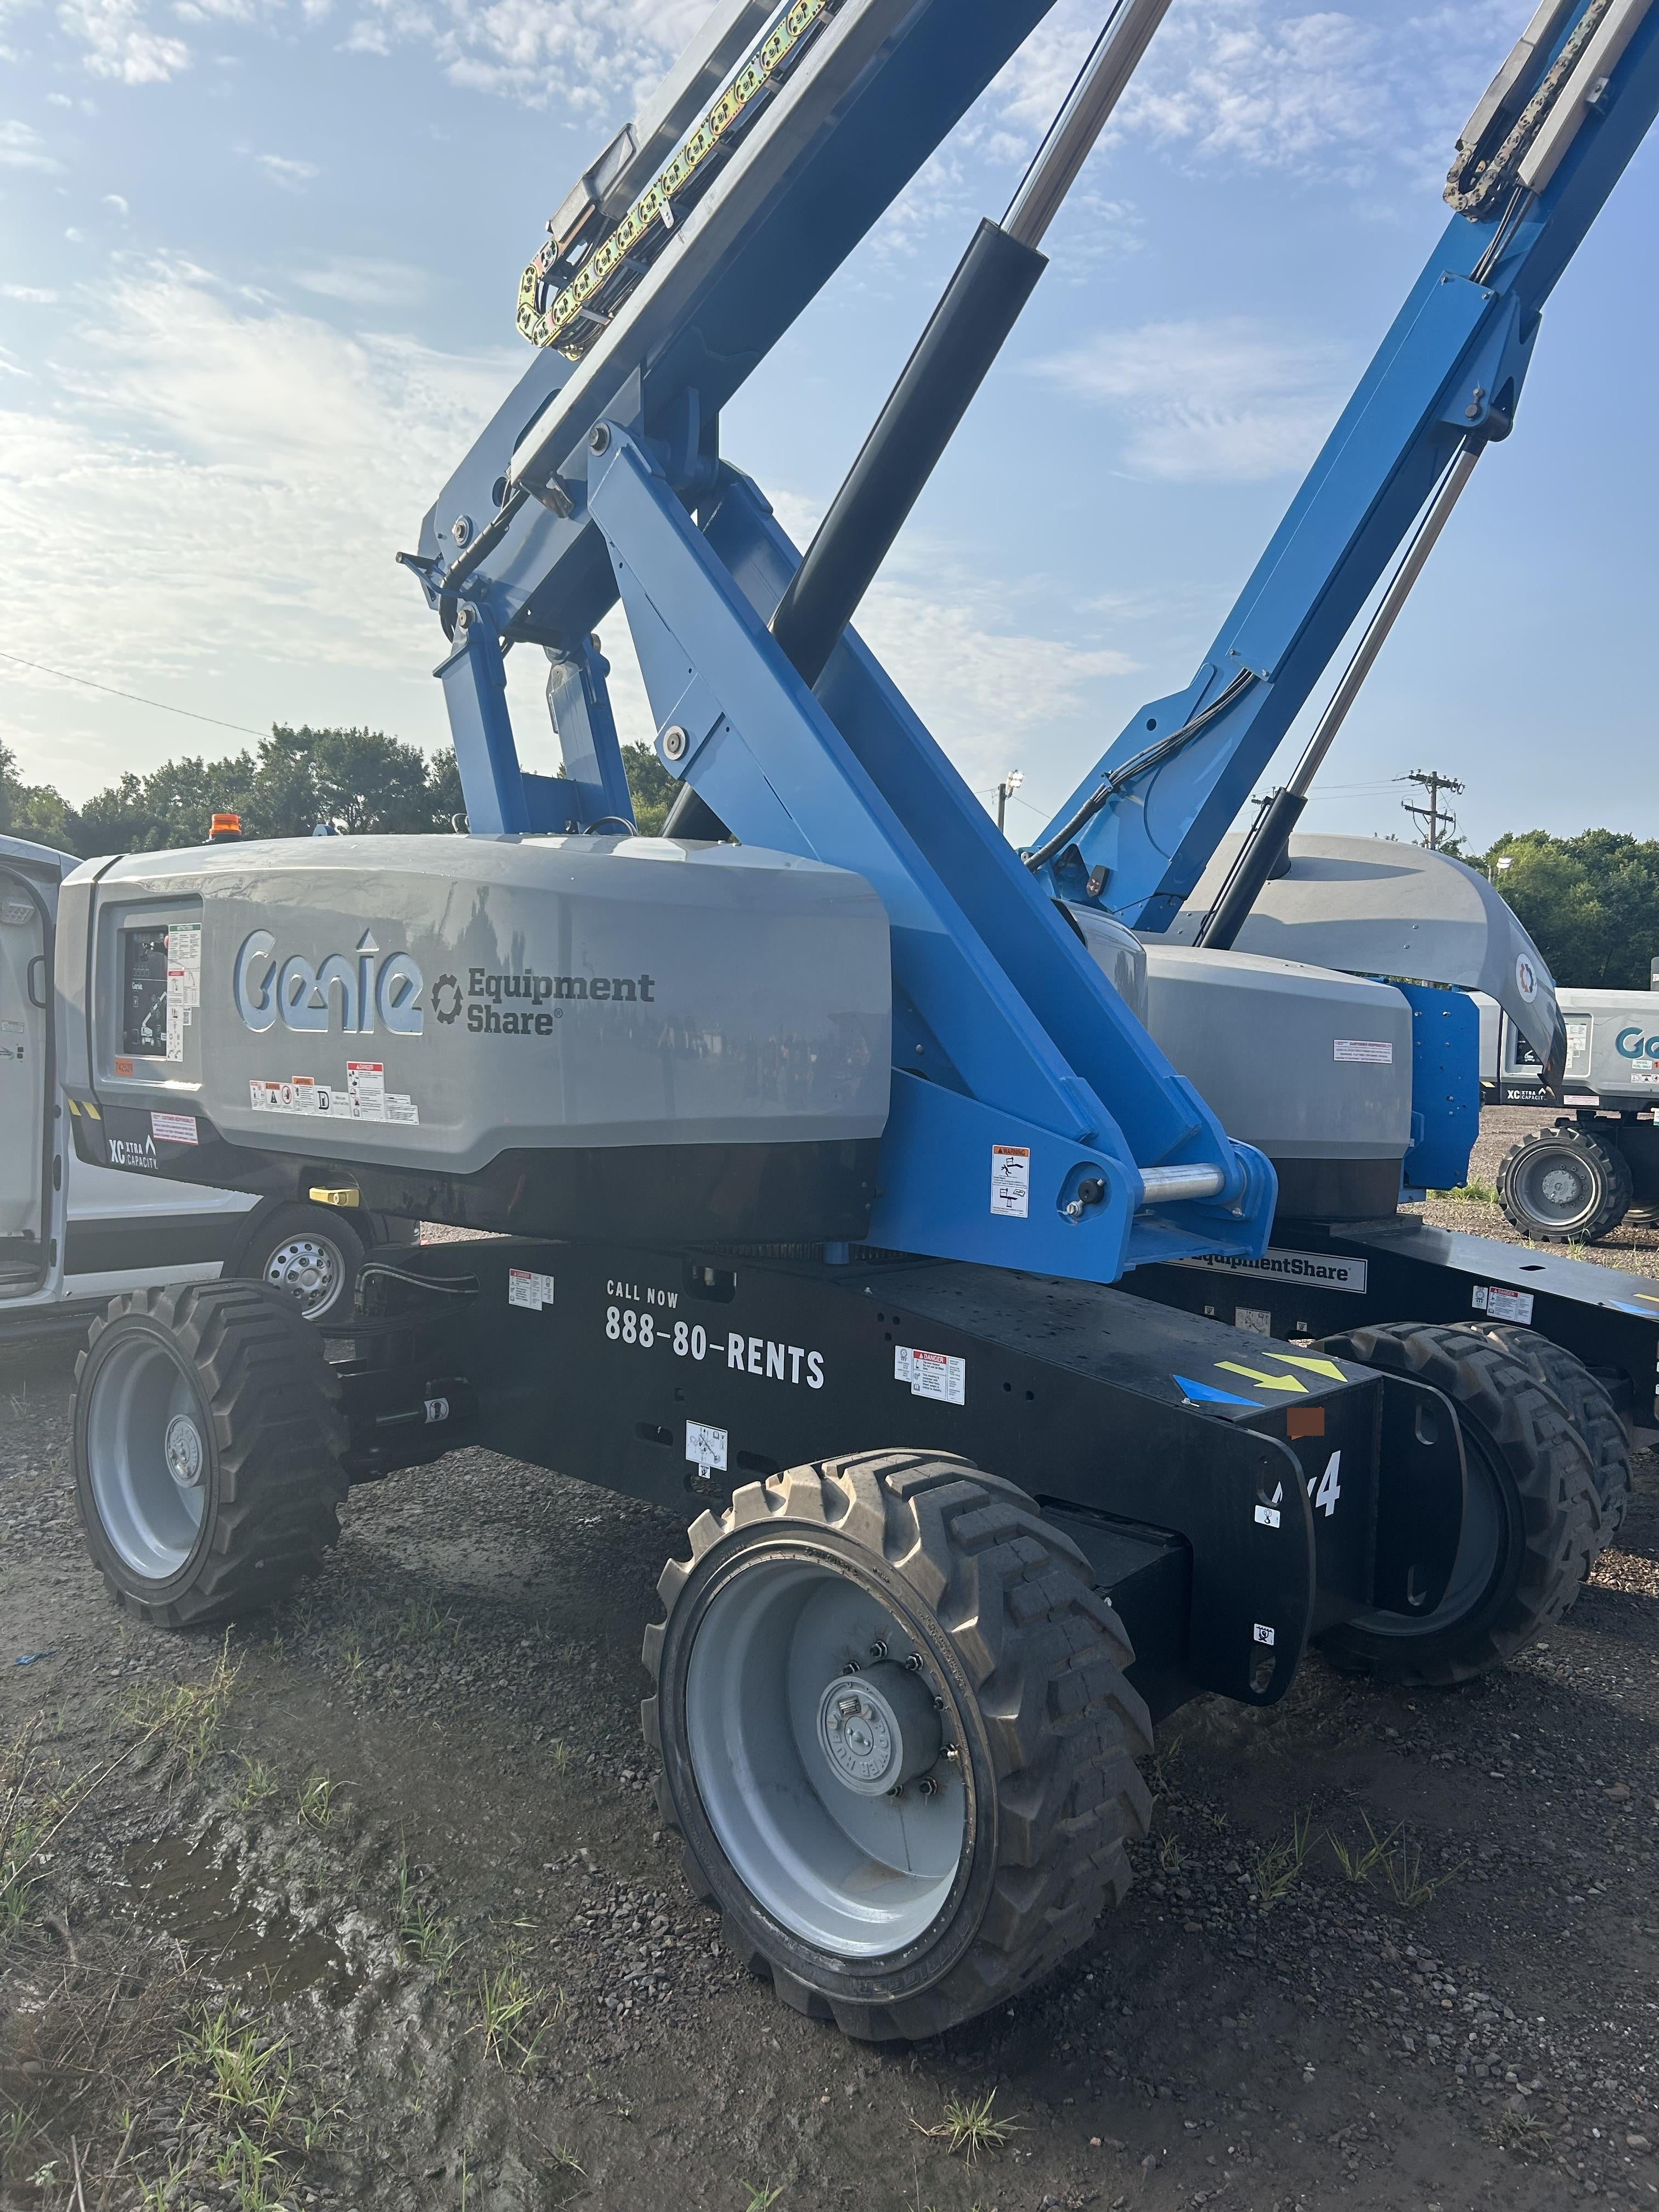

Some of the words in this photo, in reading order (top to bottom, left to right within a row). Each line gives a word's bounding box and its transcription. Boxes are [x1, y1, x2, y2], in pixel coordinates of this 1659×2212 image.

[233, 928, 424, 1036] Genie
[468, 968, 655, 1005] Equipment
[1507, 1090, 1520, 1099] XC
[109, 1139, 125, 1164] XC
[125, 1142, 143, 1154] XTRA
[127, 1154, 157, 1170] CAPACITY
[607, 1279, 640, 1301] CALL
[647, 1288, 678, 1308] NOW
[605, 1306, 824, 1389] 888-80-RENTS
[924, 1353, 944, 1363] DANGER
[859, 1719, 889, 1778] POWER
